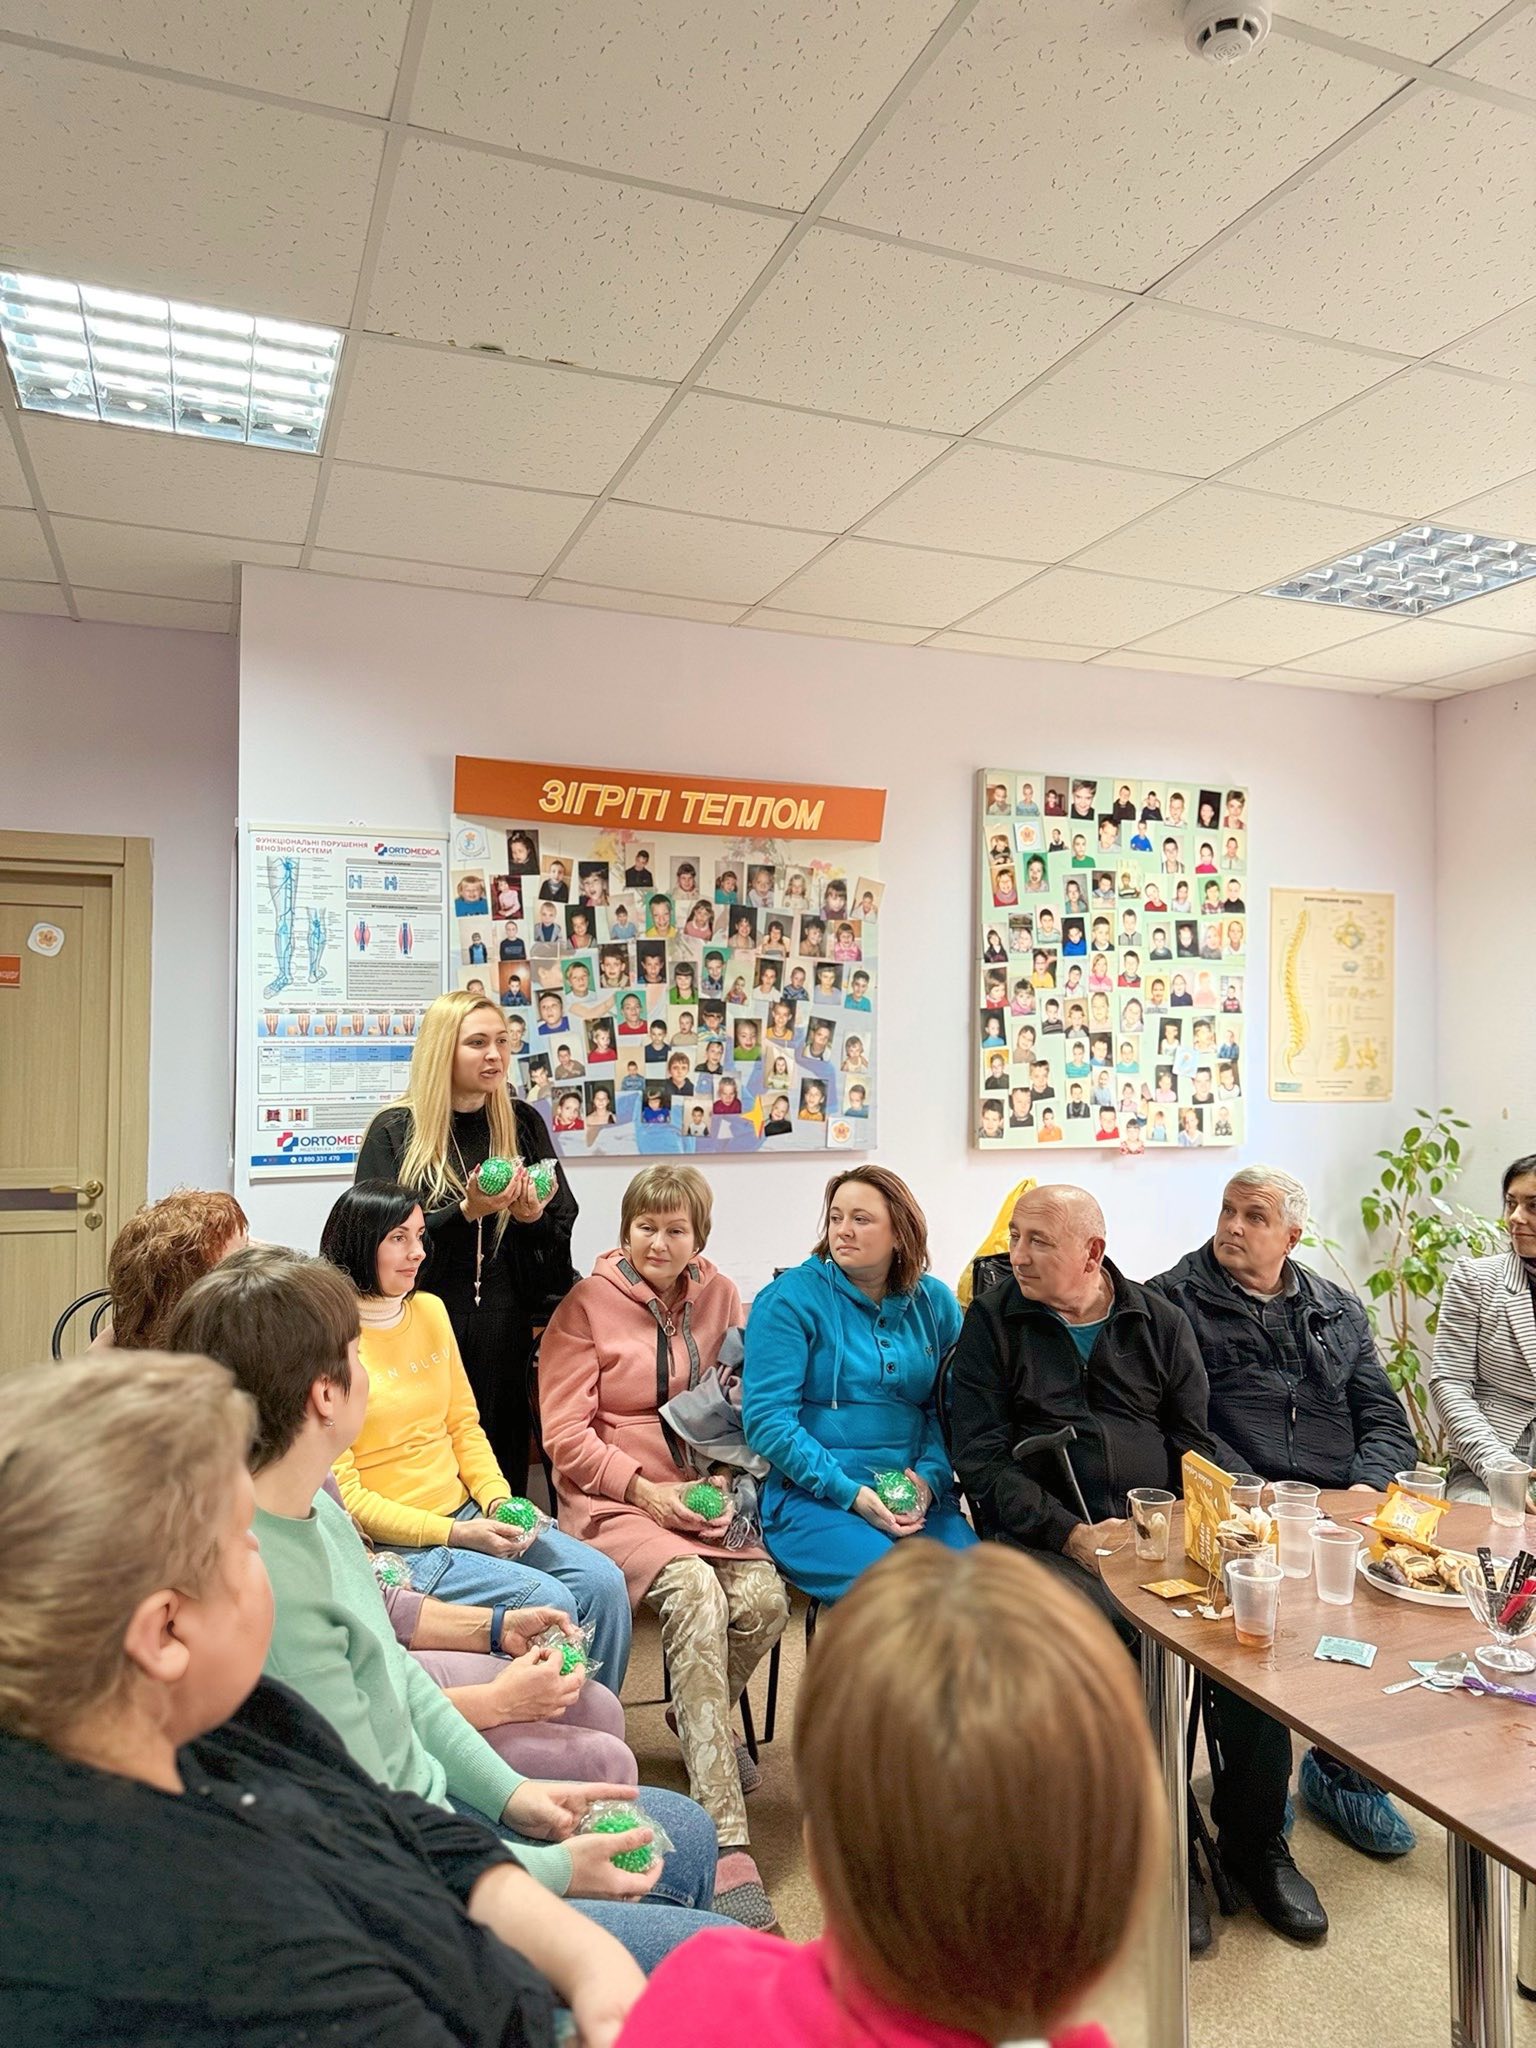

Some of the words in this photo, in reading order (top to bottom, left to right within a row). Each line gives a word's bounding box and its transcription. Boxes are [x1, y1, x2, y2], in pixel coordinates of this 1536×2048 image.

[537, 779, 671, 822] ЗІГРІТІ
[680, 791, 825, 831] ТЕПЛОМ
[256, 838, 319, 846] ФУНКЦІОНАЛЬНІ
[321, 840, 368, 848] ПОРУШЕННЯ
[255, 845, 295, 853] ВЕНОЗНОЇ
[388, 847, 440, 855] ORTOMEDICA
[300, 1135, 363, 1147] ORTOMED
